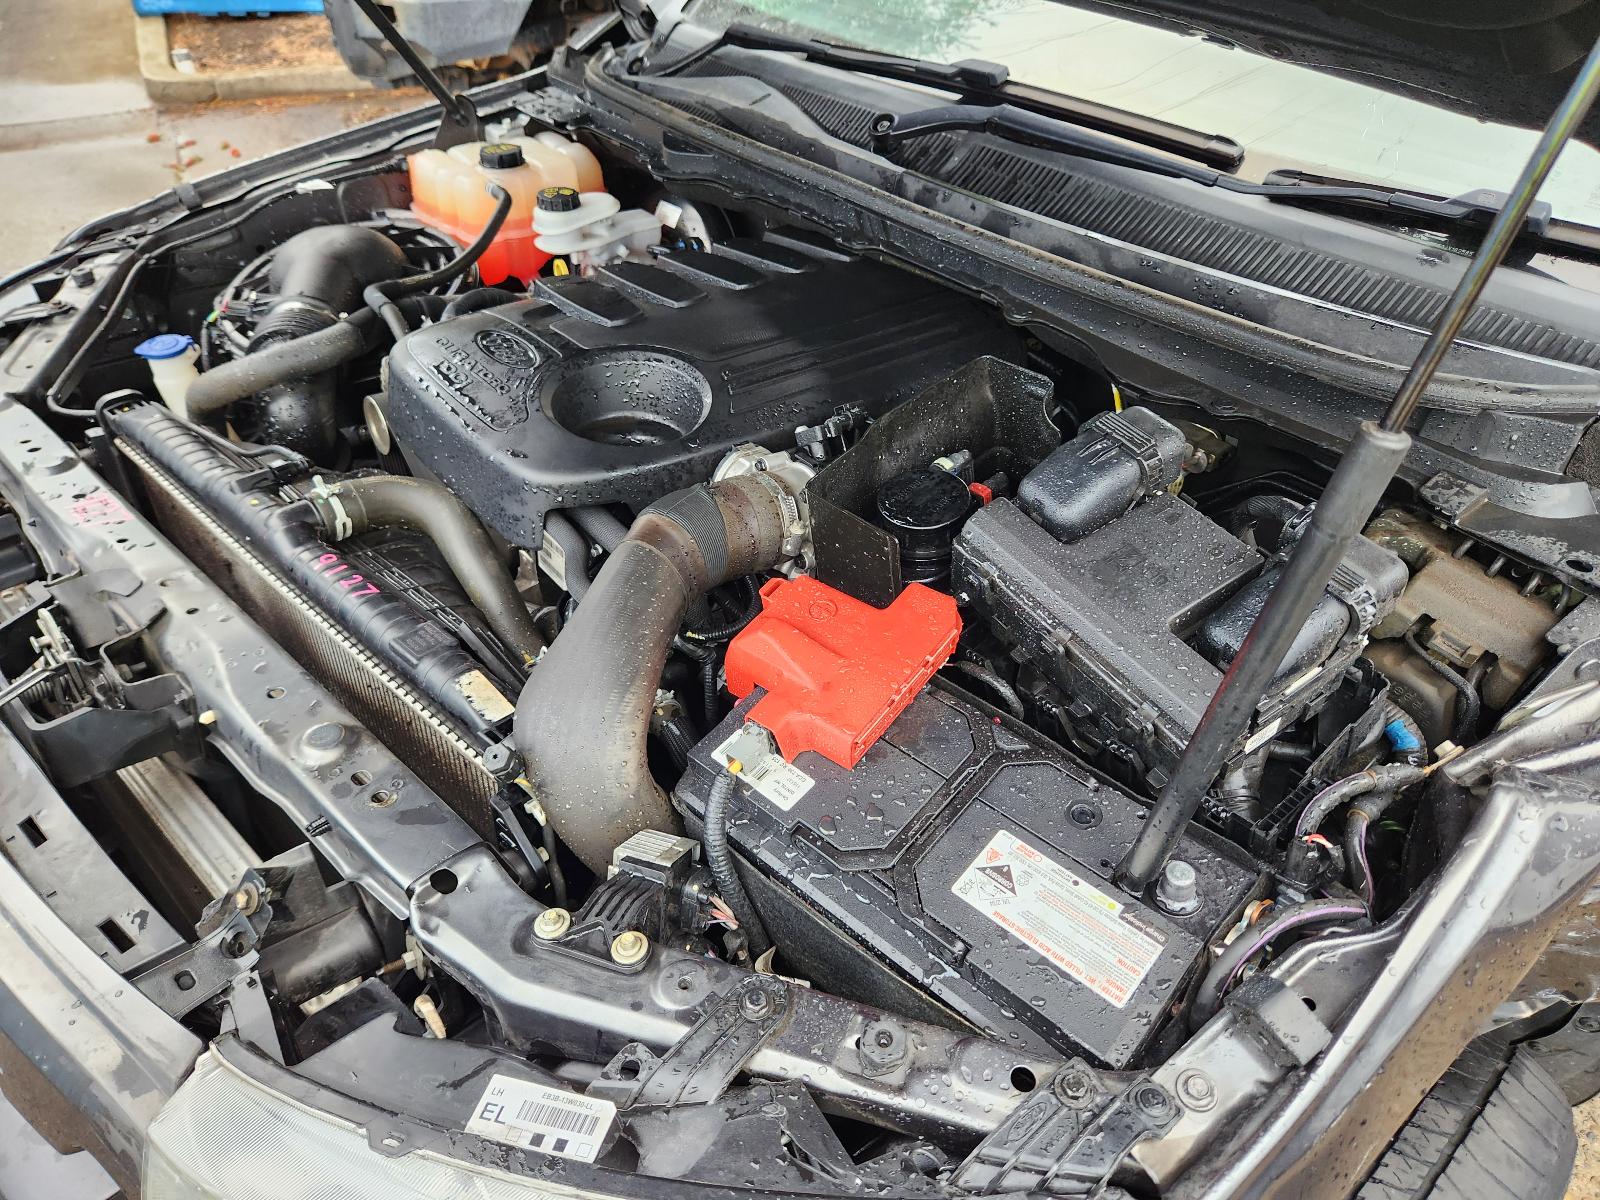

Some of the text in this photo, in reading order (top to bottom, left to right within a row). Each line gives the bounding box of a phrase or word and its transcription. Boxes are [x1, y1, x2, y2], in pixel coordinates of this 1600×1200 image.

[313, 552, 381, 598] 9127
[984, 866, 1013, 889] CORROSIVE
[992, 909, 1016, 928] STORAGE
[1013, 924, 1039, 944] ELECTRIC
[1037, 940, 1052, 954] ACID
[1050, 949, 1065, 963] WITH
[1063, 958, 1084, 975] FILLED
[491, 1087, 505, 1097] LH
[479, 1101, 506, 1125] EL
